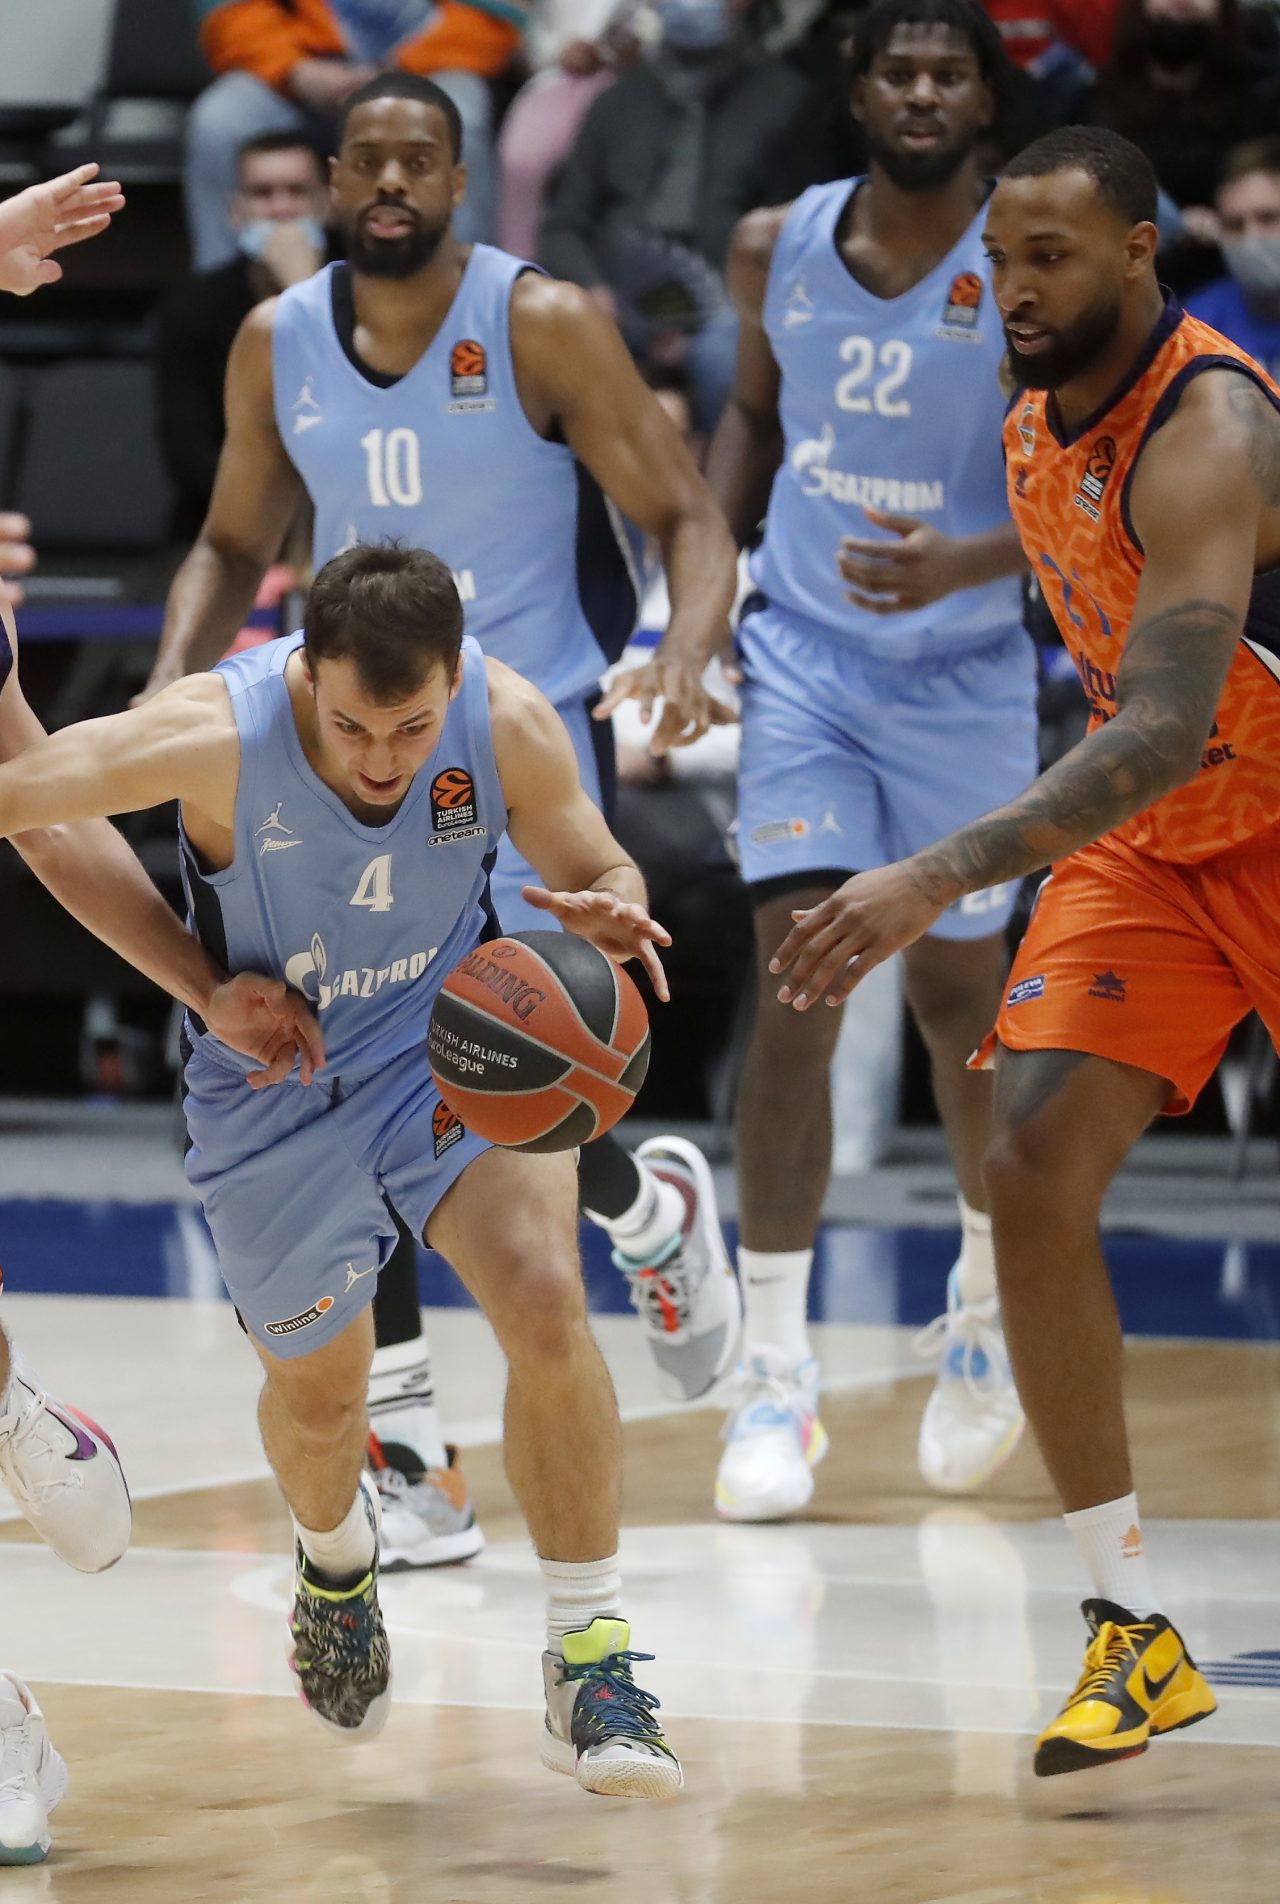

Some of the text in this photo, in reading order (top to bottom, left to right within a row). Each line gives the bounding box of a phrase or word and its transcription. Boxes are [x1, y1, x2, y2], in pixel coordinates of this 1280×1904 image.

[835, 335, 913, 417] 22
[361, 427, 422, 507] 10
[436, 804, 473, 818] TURKISH
[437, 810, 474, 824] AIRLINES
[428, 827, 486, 846] oneteam
[349, 854, 394, 911] 4
[460, 1040, 518, 1069] AIRLINES
[269, 1312, 317, 1333] Winline
